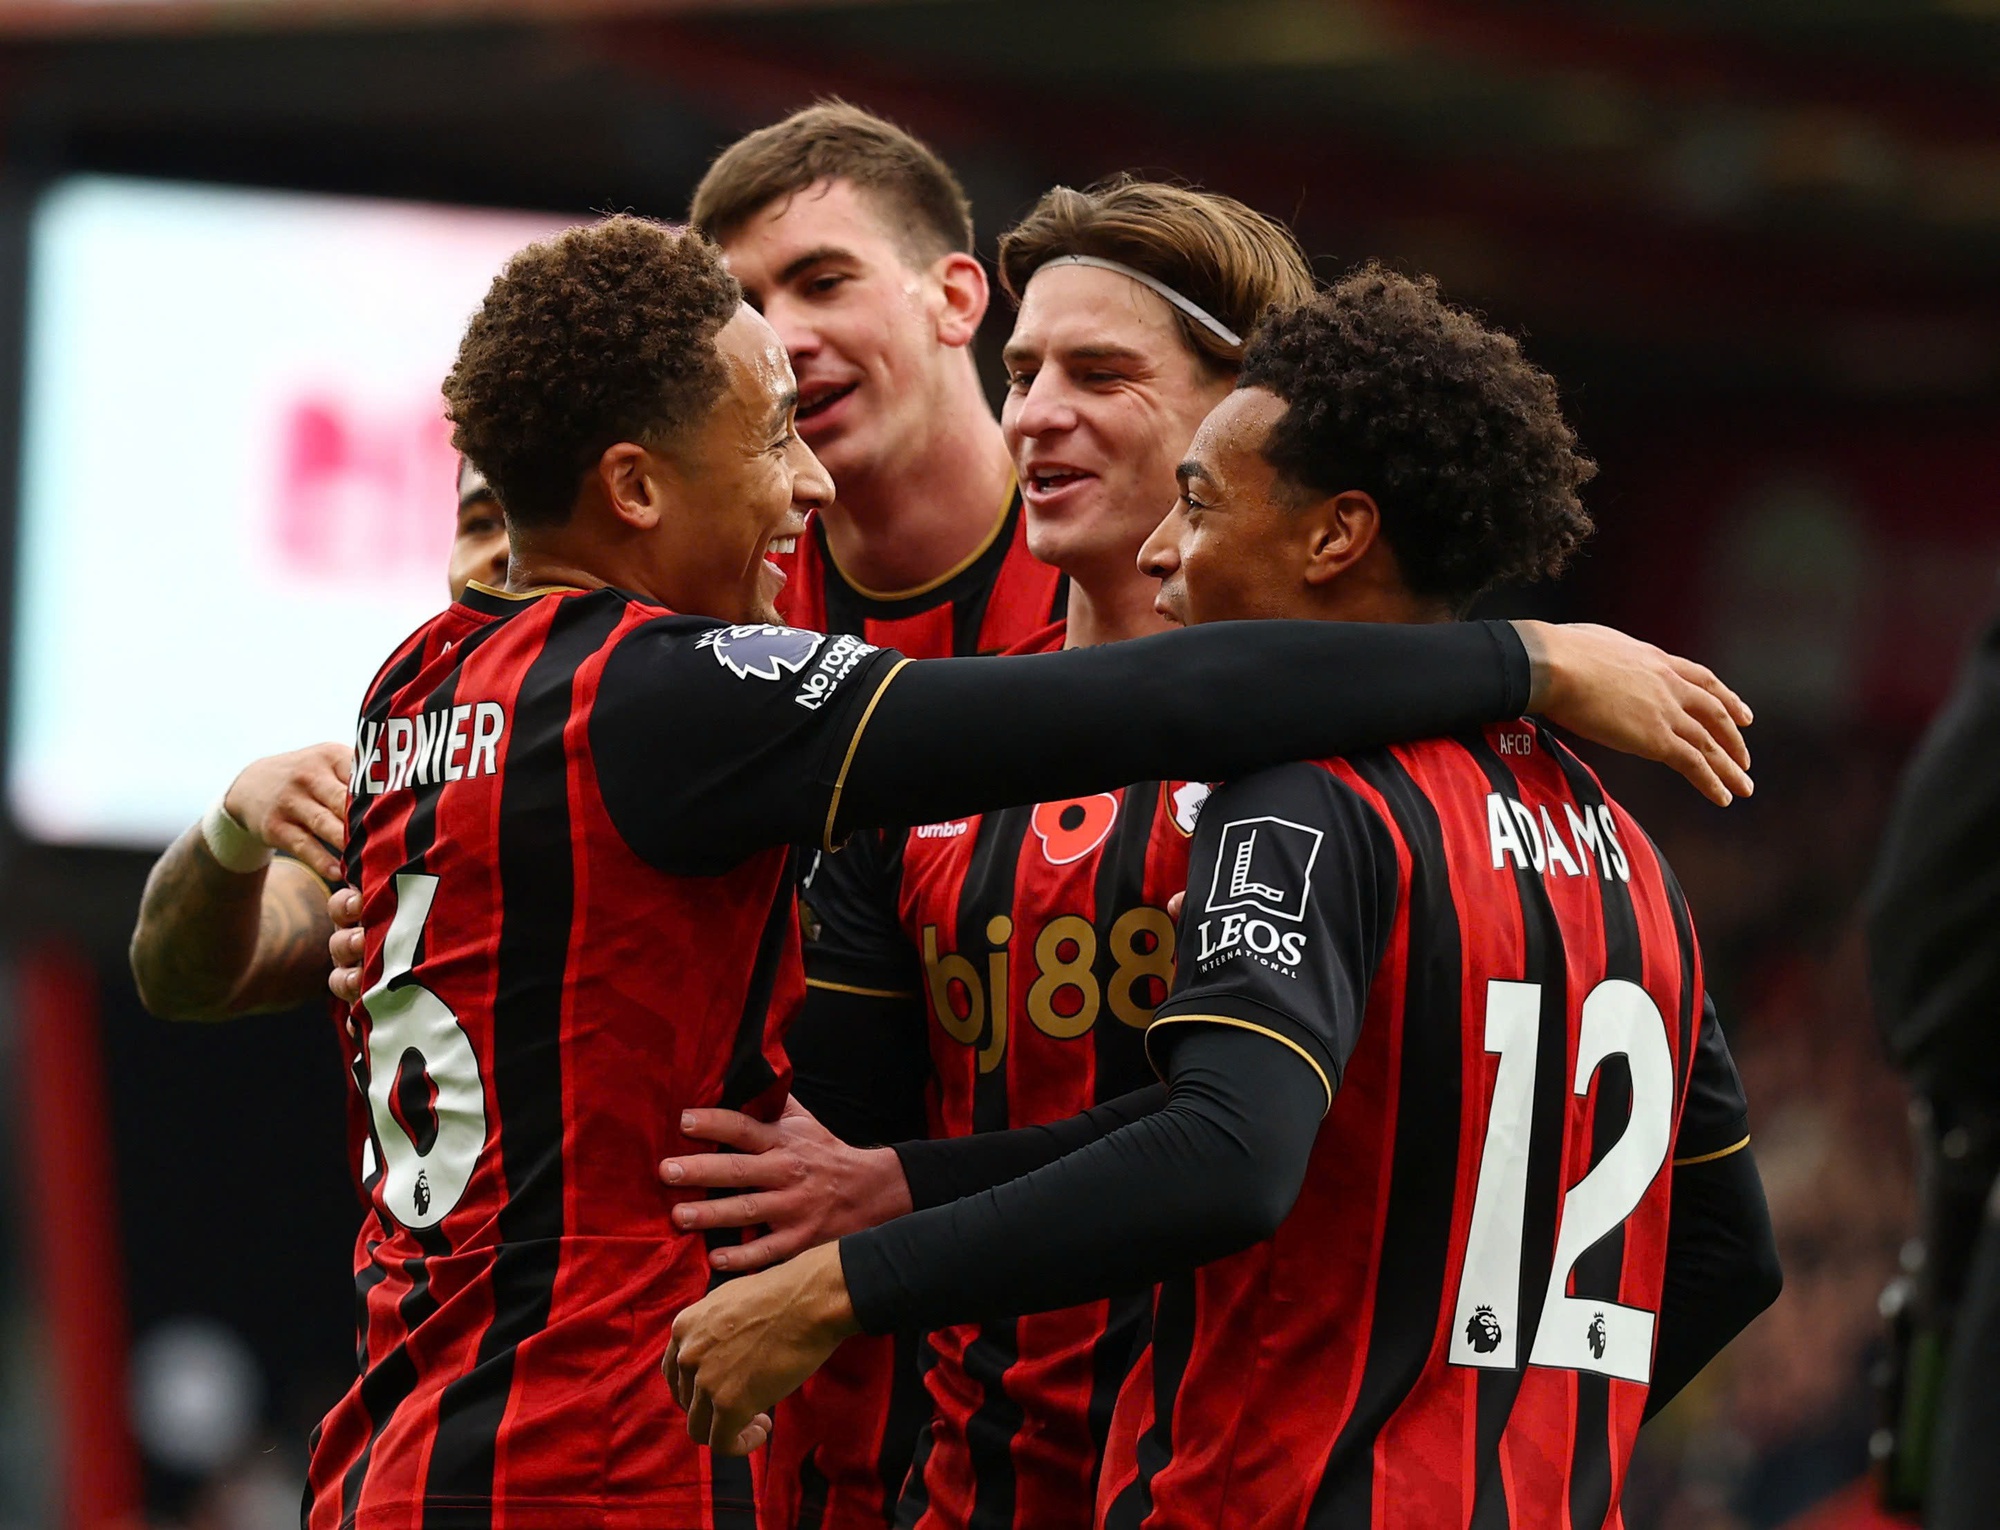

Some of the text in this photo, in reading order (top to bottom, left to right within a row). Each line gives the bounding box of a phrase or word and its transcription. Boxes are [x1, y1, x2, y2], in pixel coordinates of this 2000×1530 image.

[795, 673, 829, 710] No
[1500, 734, 1531, 756] AFCB
[1486, 792, 1631, 883] ADAMS
[1196, 913, 1306, 966] LEOS
[923, 906, 1176, 1074] bj88
[352, 873, 486, 1229] 6
[1448, 978, 1674, 1384] 12
